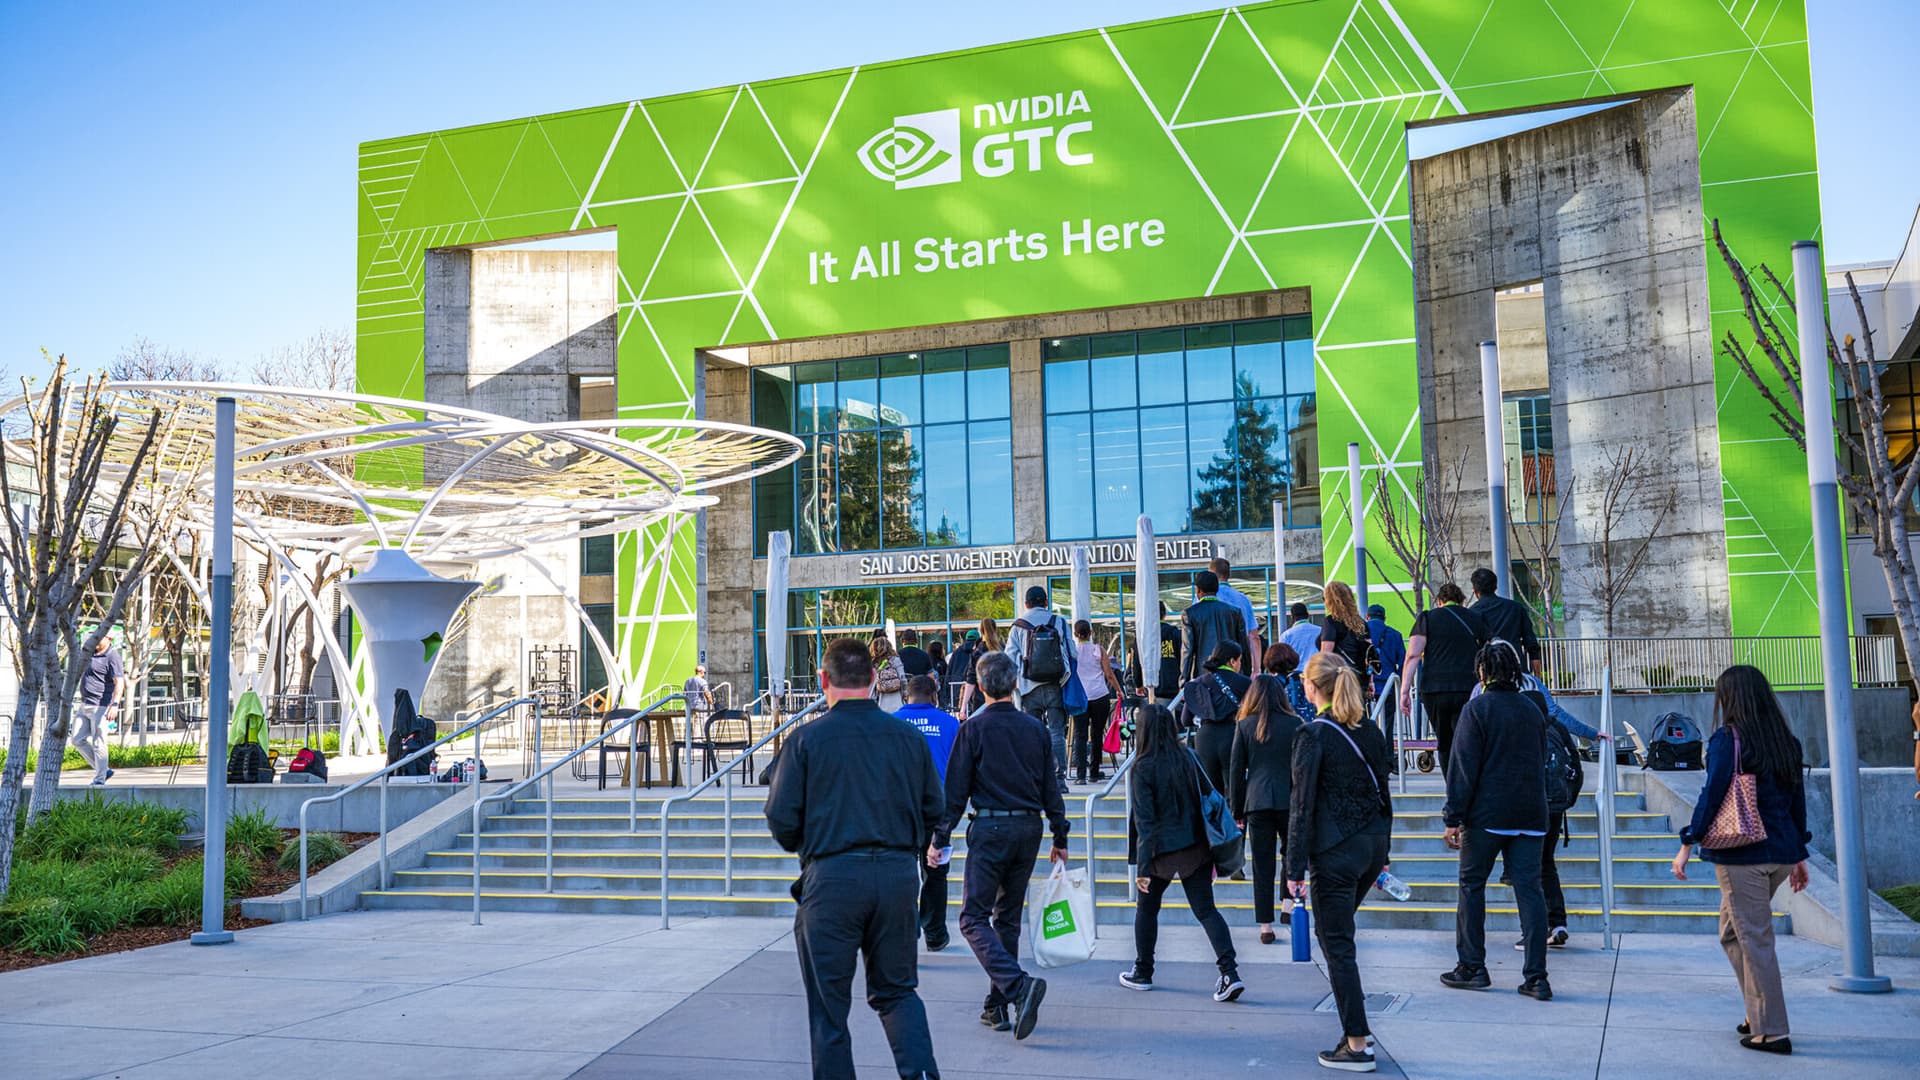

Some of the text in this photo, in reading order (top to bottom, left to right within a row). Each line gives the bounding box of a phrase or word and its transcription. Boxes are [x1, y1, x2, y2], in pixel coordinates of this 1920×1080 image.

[972, 121, 1093, 177] GTC
[809, 217, 1165, 285] It All Starts Here
[860, 539, 1211, 575] SAN JOSE McENERY CONVNTION ENTER
